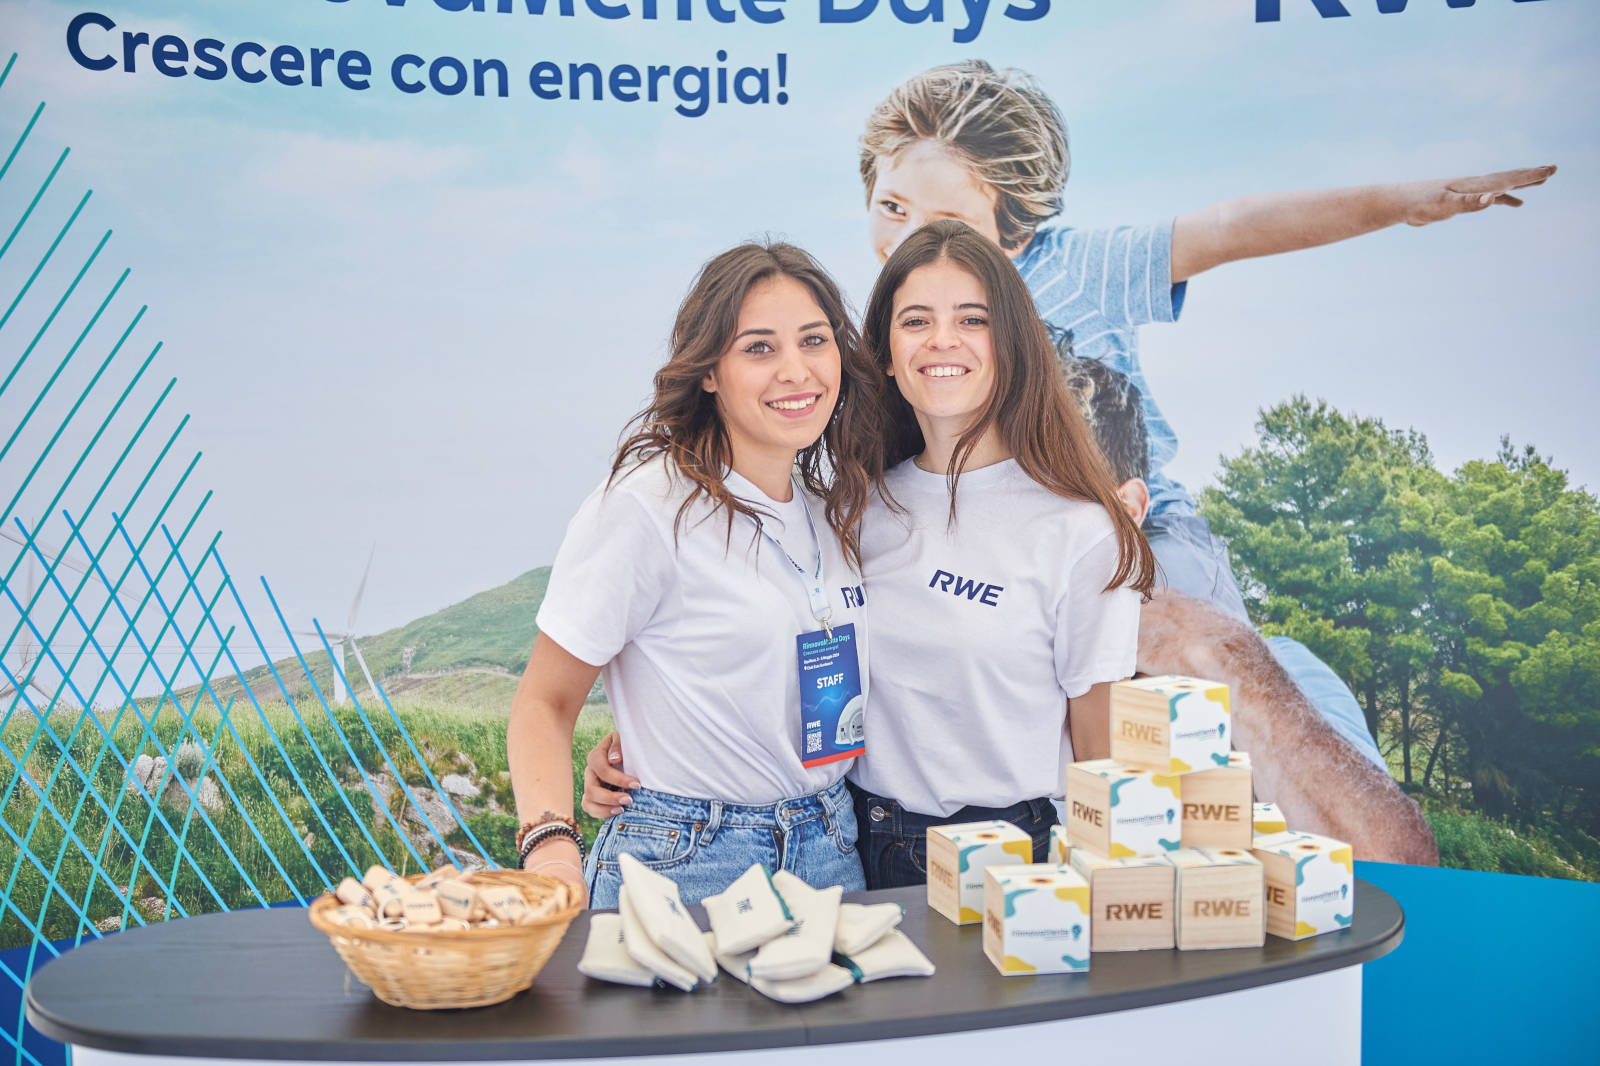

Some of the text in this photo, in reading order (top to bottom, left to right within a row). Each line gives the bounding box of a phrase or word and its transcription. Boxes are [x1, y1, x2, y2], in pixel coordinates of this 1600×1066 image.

[66, 12, 789, 118] Crescere con energia!
[929, 569, 1004, 607] RWE
[816, 672, 844, 689] STAFF
[1121, 720, 1162, 745] RWE
[1072, 801, 1103, 828] RWE
[1183, 803, 1241, 822] RWE
[1105, 903, 1163, 921] RWE
[1193, 899, 1251, 918] RWE
